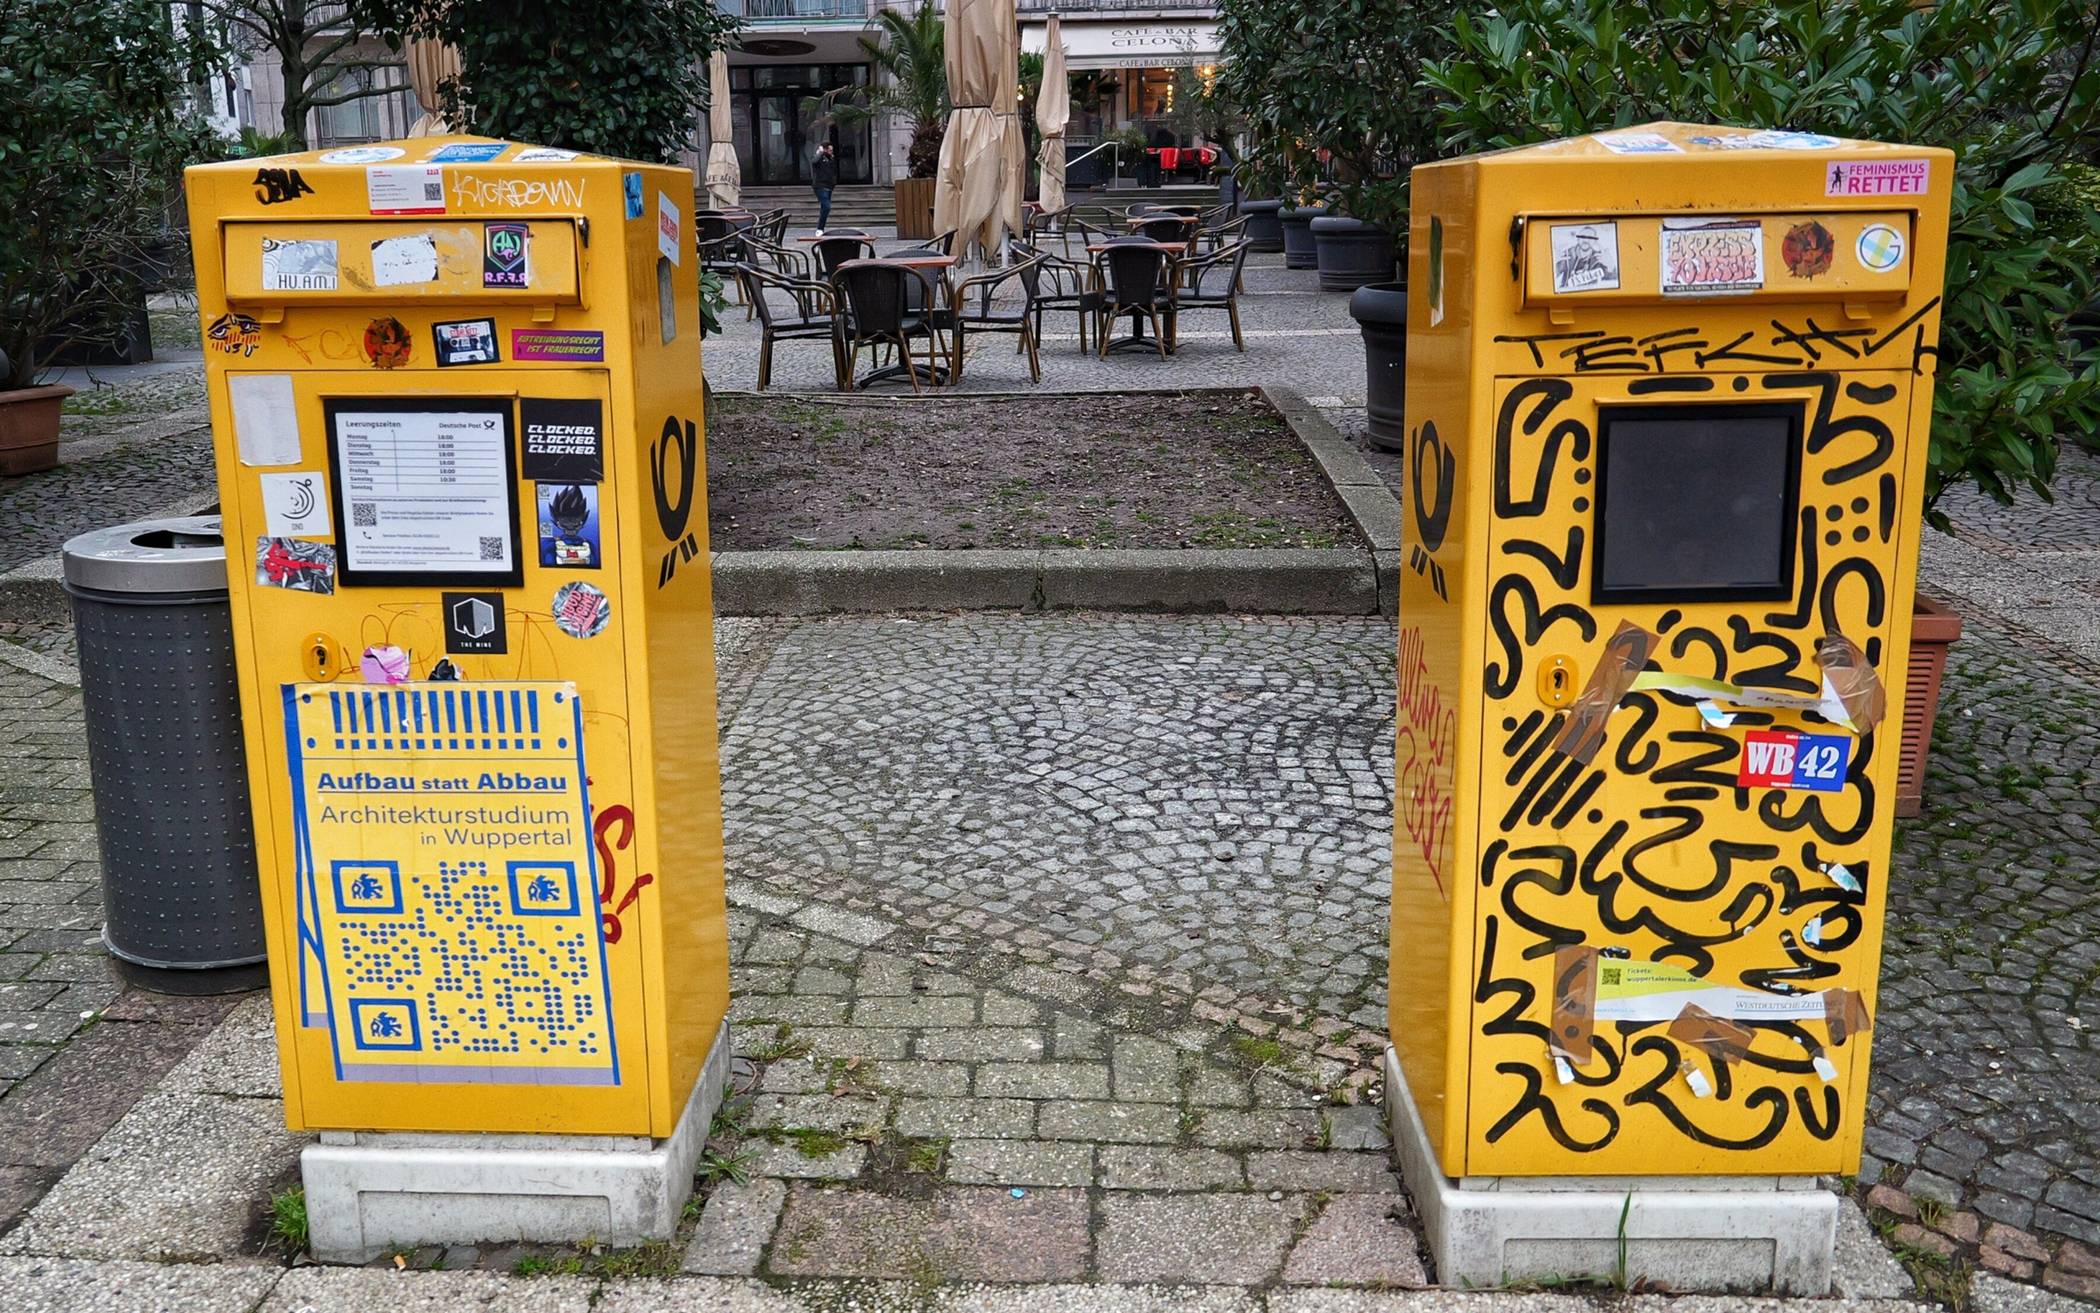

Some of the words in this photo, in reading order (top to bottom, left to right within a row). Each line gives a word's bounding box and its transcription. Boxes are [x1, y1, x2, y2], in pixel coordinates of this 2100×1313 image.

[1111, 37, 1198, 47] CELONA
[1849, 163, 1925, 175] FEMINISMUS
[1848, 175, 1924, 194] RETTET
[345, 420, 401, 428] Leerungszeiten
[527, 424, 596, 436] CLOCKED.
[528, 434, 596, 445] CLOCKED.
[528, 444, 597, 455] CLOCKED.
[1747, 741, 1795, 776] WB
[1798, 745, 1840, 779] 42
[317, 772, 415, 790] Aufbau
[422, 777, 469, 790] statt
[477, 772, 567, 790] Abbau
[320, 805, 570, 825] Architekturstudium
[421, 831, 436, 845] in
[444, 828, 572, 849] Wuppertal
